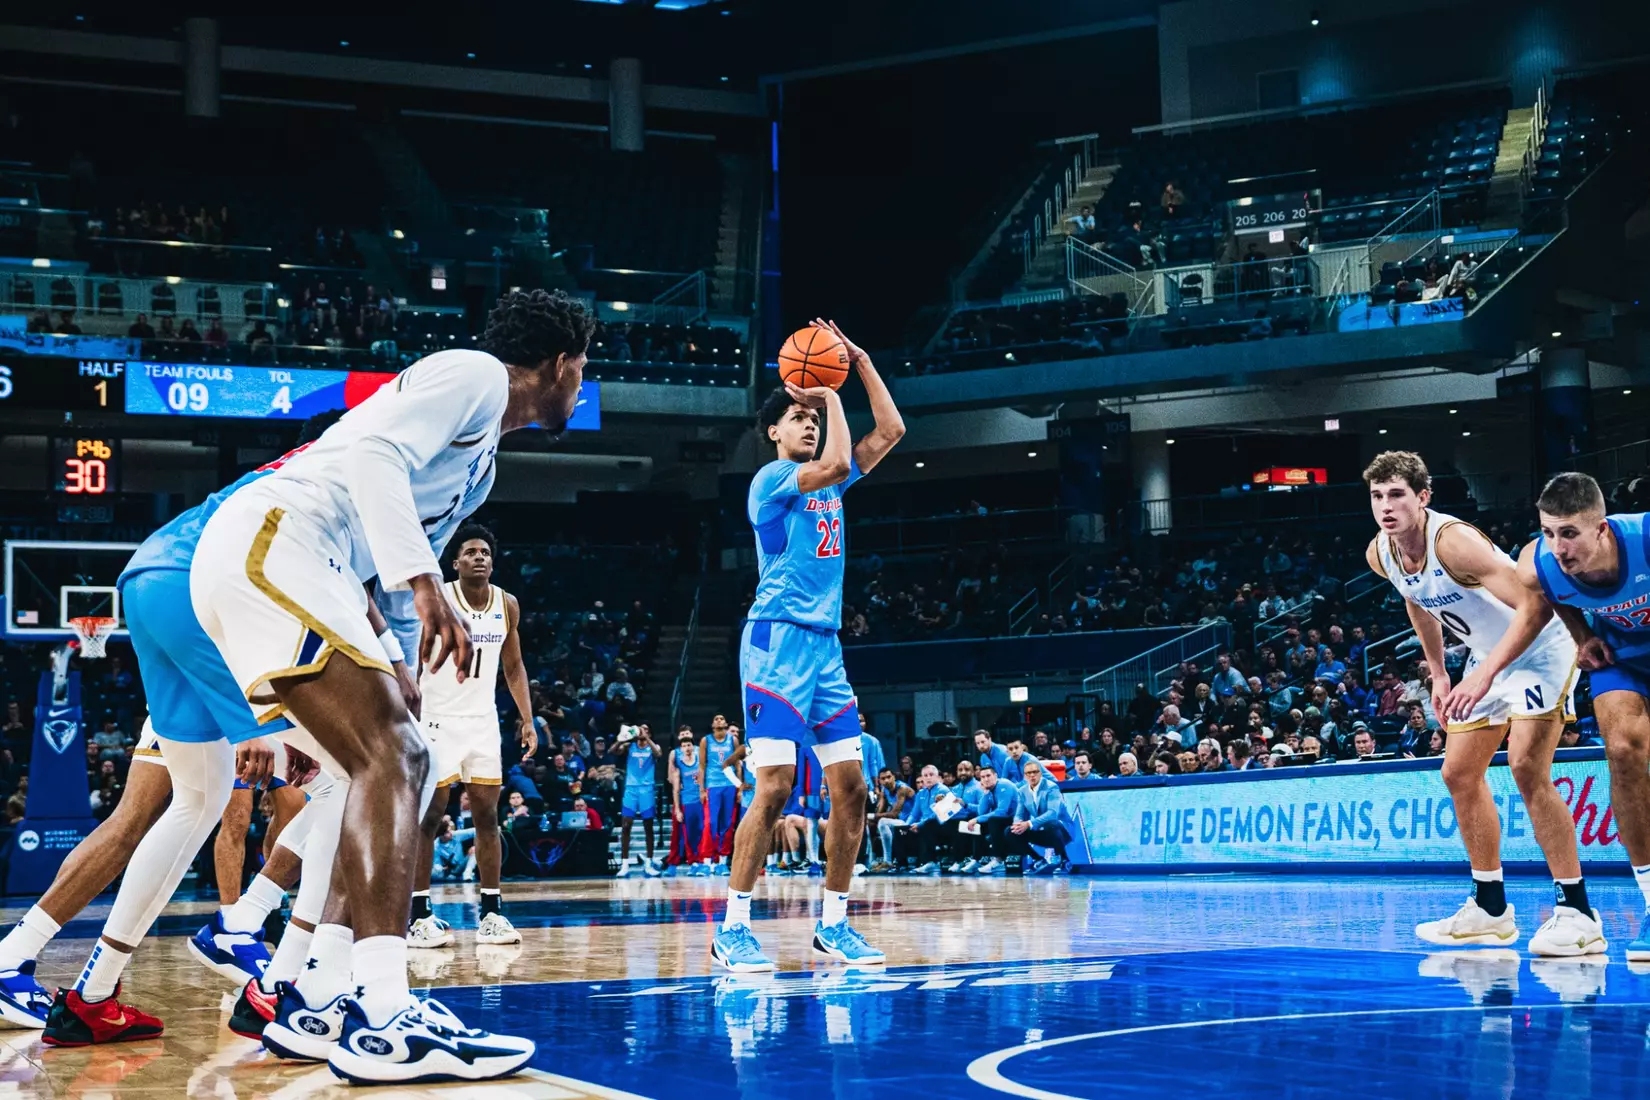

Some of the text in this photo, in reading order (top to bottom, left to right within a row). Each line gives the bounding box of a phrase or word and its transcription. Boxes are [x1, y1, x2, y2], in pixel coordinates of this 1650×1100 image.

[1235, 214, 1257, 227] 205
[1263, 211, 1285, 223] 206
[78, 360, 124, 377] HALF
[144, 364, 234, 381] TEAM FOULS
[268, 370, 295, 384] TOL
[94, 380, 107, 406] 1
[168, 382, 209, 411] 09
[271, 385, 293, 414] 4
[65, 459, 106, 492] 30
[816, 517, 841, 558] 22
[1524, 684, 1545, 710] N
[1140, 808, 1195, 845] BLUE
[1200, 803, 1295, 844] DEMON
[1303, 800, 1381, 850] FANS,
